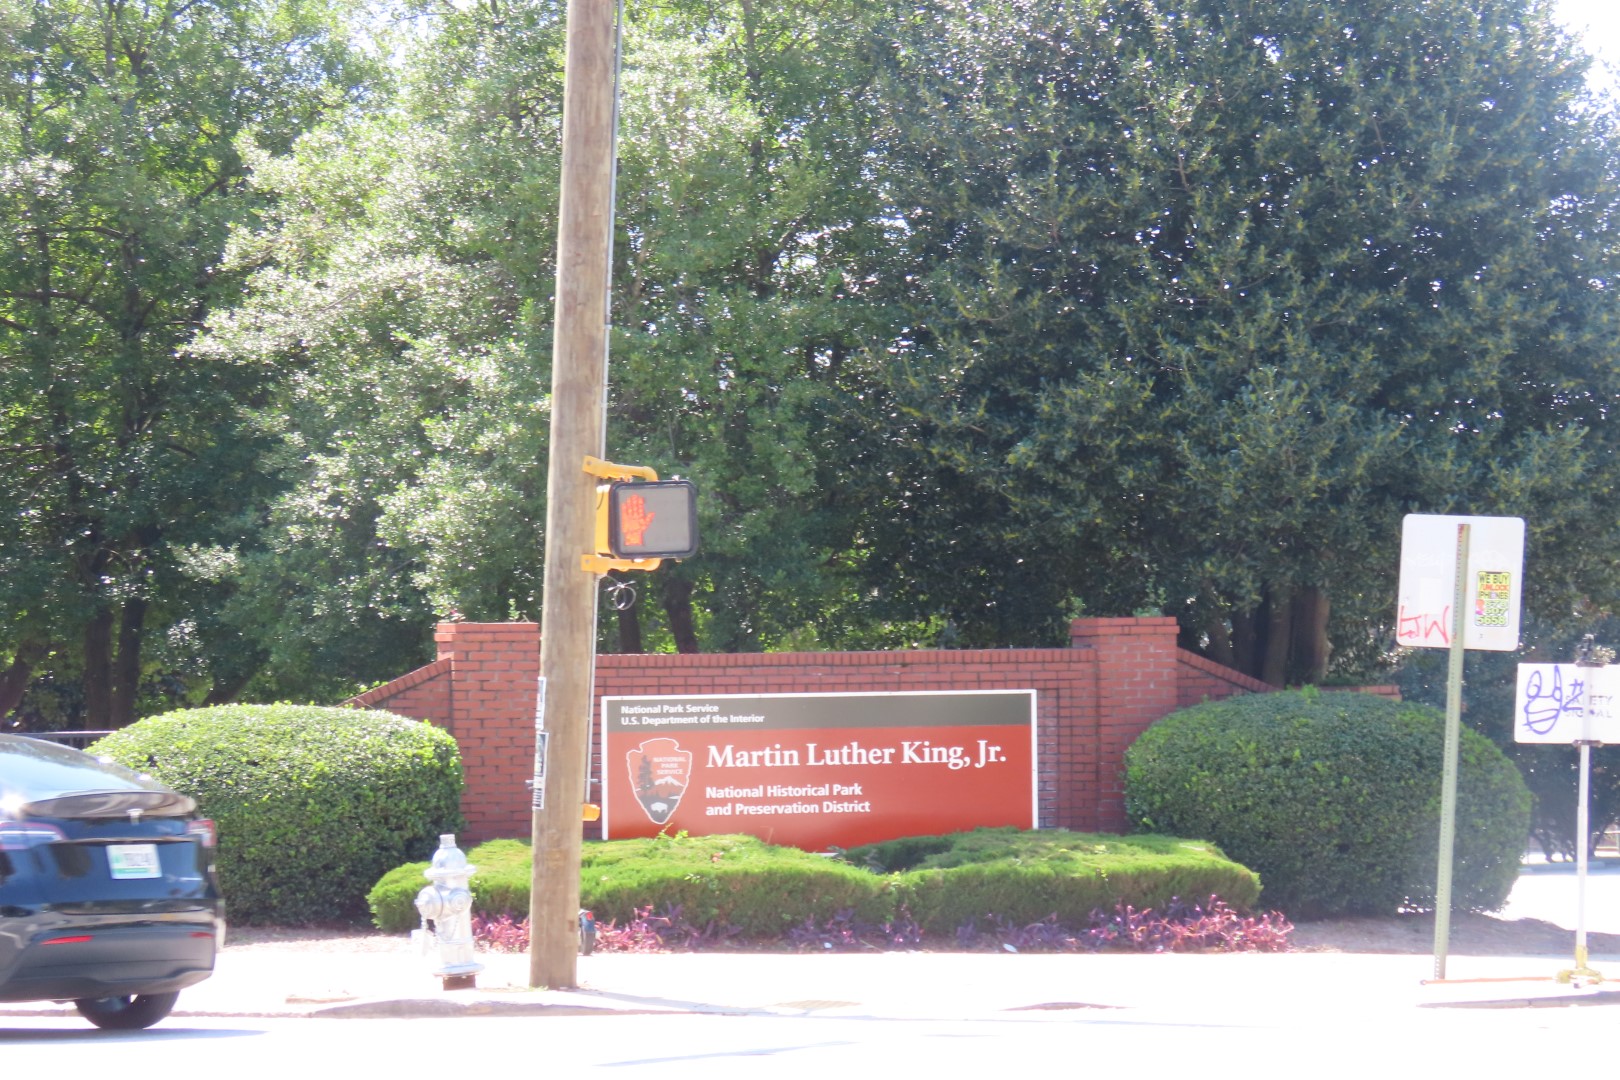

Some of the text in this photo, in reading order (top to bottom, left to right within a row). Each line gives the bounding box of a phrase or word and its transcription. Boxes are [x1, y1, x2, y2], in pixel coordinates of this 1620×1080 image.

[1479, 574, 1508, 584] WE BUY
[621, 704, 719, 714] National Park Service
[621, 715, 765, 726] U.S. Department of the Interior
[705, 739, 1007, 770] Martin Luther King, Jr.
[705, 783, 863, 799] National Historical Park
[705, 801, 871, 816] and Preservation District
